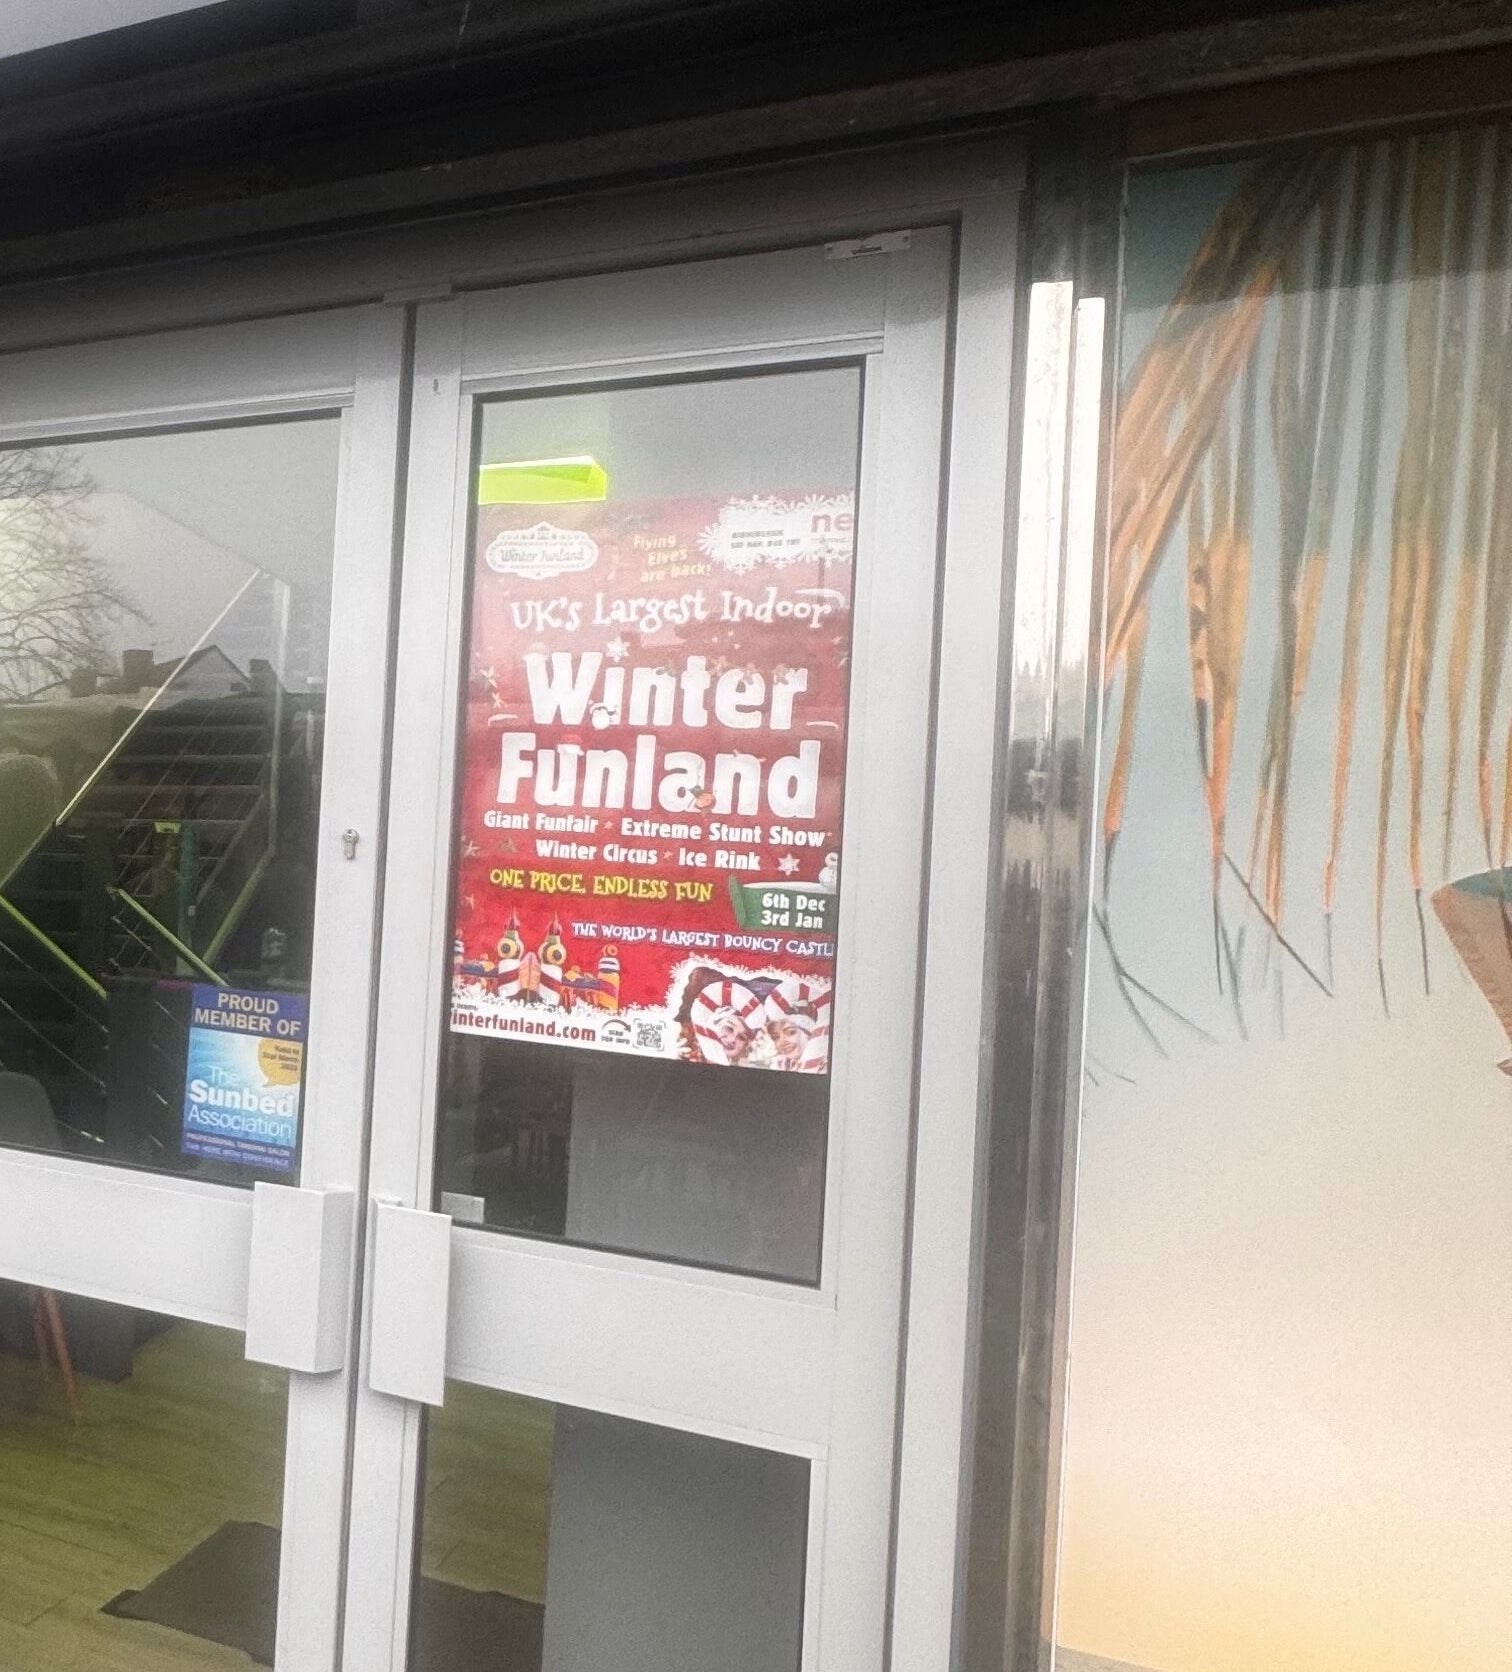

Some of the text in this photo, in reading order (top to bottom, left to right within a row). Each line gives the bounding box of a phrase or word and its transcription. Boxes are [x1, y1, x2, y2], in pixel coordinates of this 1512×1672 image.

[632, 534, 677, 550] Flying
[640, 562, 712, 584] are back!
[510, 586, 832, 634] UK's Largest Indoor
[524, 651, 808, 731] Winter
[497, 732, 822, 820] Funland
[483, 809, 825, 848] Giant Funfair Extreme Stunt Show
[536, 838, 761, 872] Winter Circus Ice Rink
[489, 867, 524, 888] ONE
[592, 875, 669, 901] ENDLESS
[674, 880, 714, 903] FUN
[760, 908, 823, 930] 3rd Jan
[761, 892, 826, 913] 6th Dec
[571, 921, 597, 937] THE
[601, 923, 657, 944] WORLD'S
[662, 927, 721, 949] LARGEST
[724, 933, 781, 954] BOUNCY
[217, 992, 279, 1015] PROUD
[194, 1008, 302, 1036] MEMBER OF
[207, 1065, 240, 1088] The
[189, 1078, 295, 1118] Sunbed
[188, 1104, 292, 1138] Association
